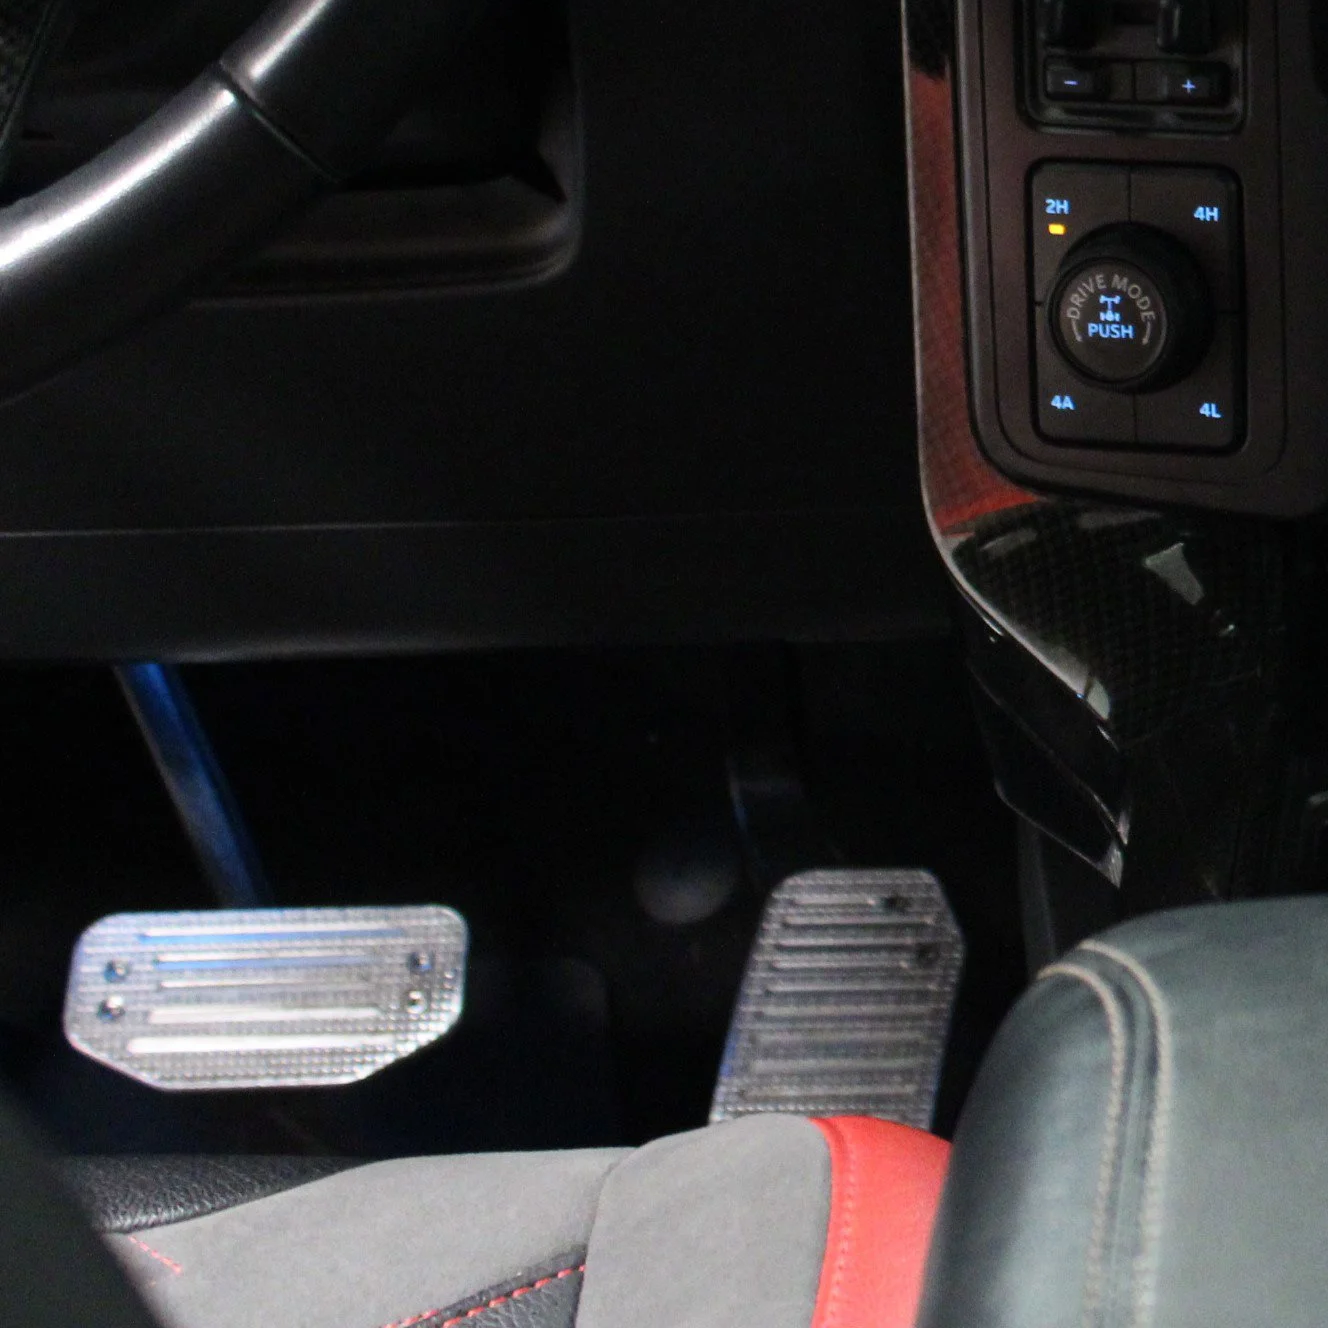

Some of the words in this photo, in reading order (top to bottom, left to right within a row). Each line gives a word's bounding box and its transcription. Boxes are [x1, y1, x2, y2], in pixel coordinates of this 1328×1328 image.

[1046, 199, 1070, 214] 2H
[1194, 207, 1219, 221] 4H
[1067, 274, 1106, 319] DRIVE
[1111, 274, 1155, 322] MODE
[1088, 324, 1133, 339] PUSH
[1051, 395, 1074, 409] 4A
[1200, 403, 1221, 418] 4L
